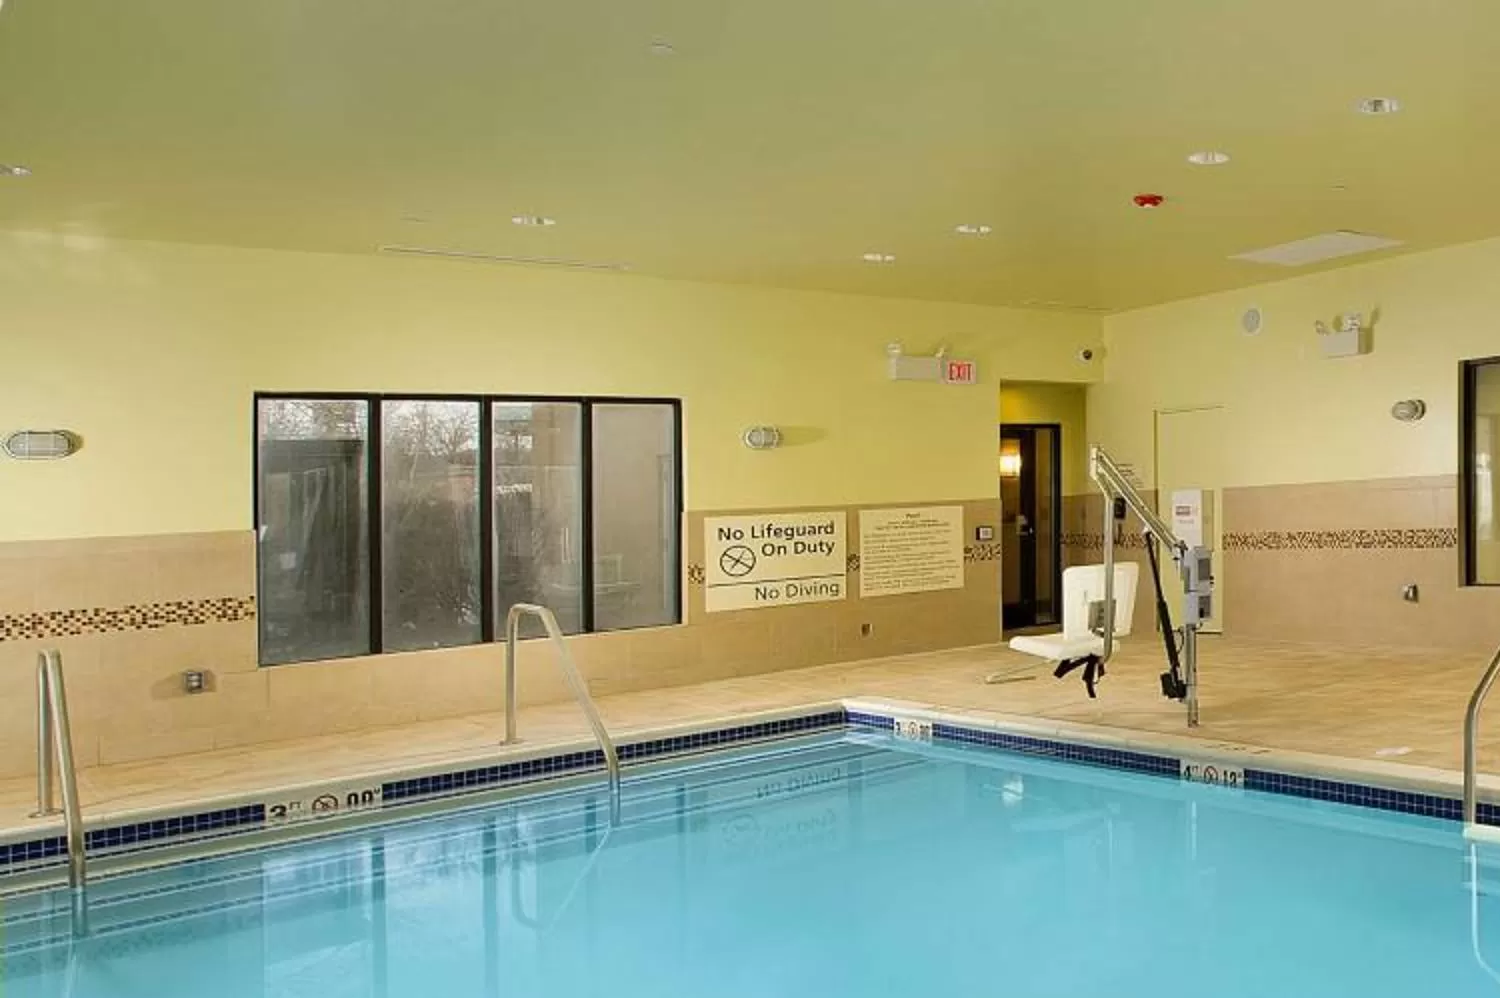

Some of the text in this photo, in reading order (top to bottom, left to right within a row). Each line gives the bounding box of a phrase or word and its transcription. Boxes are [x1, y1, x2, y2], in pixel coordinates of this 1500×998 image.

[949, 363, 972, 381] EXIT
[717, 520, 835, 541] No Lifeguard
[761, 540, 835, 557] On Duty
[755, 581, 840, 601] No Diving
